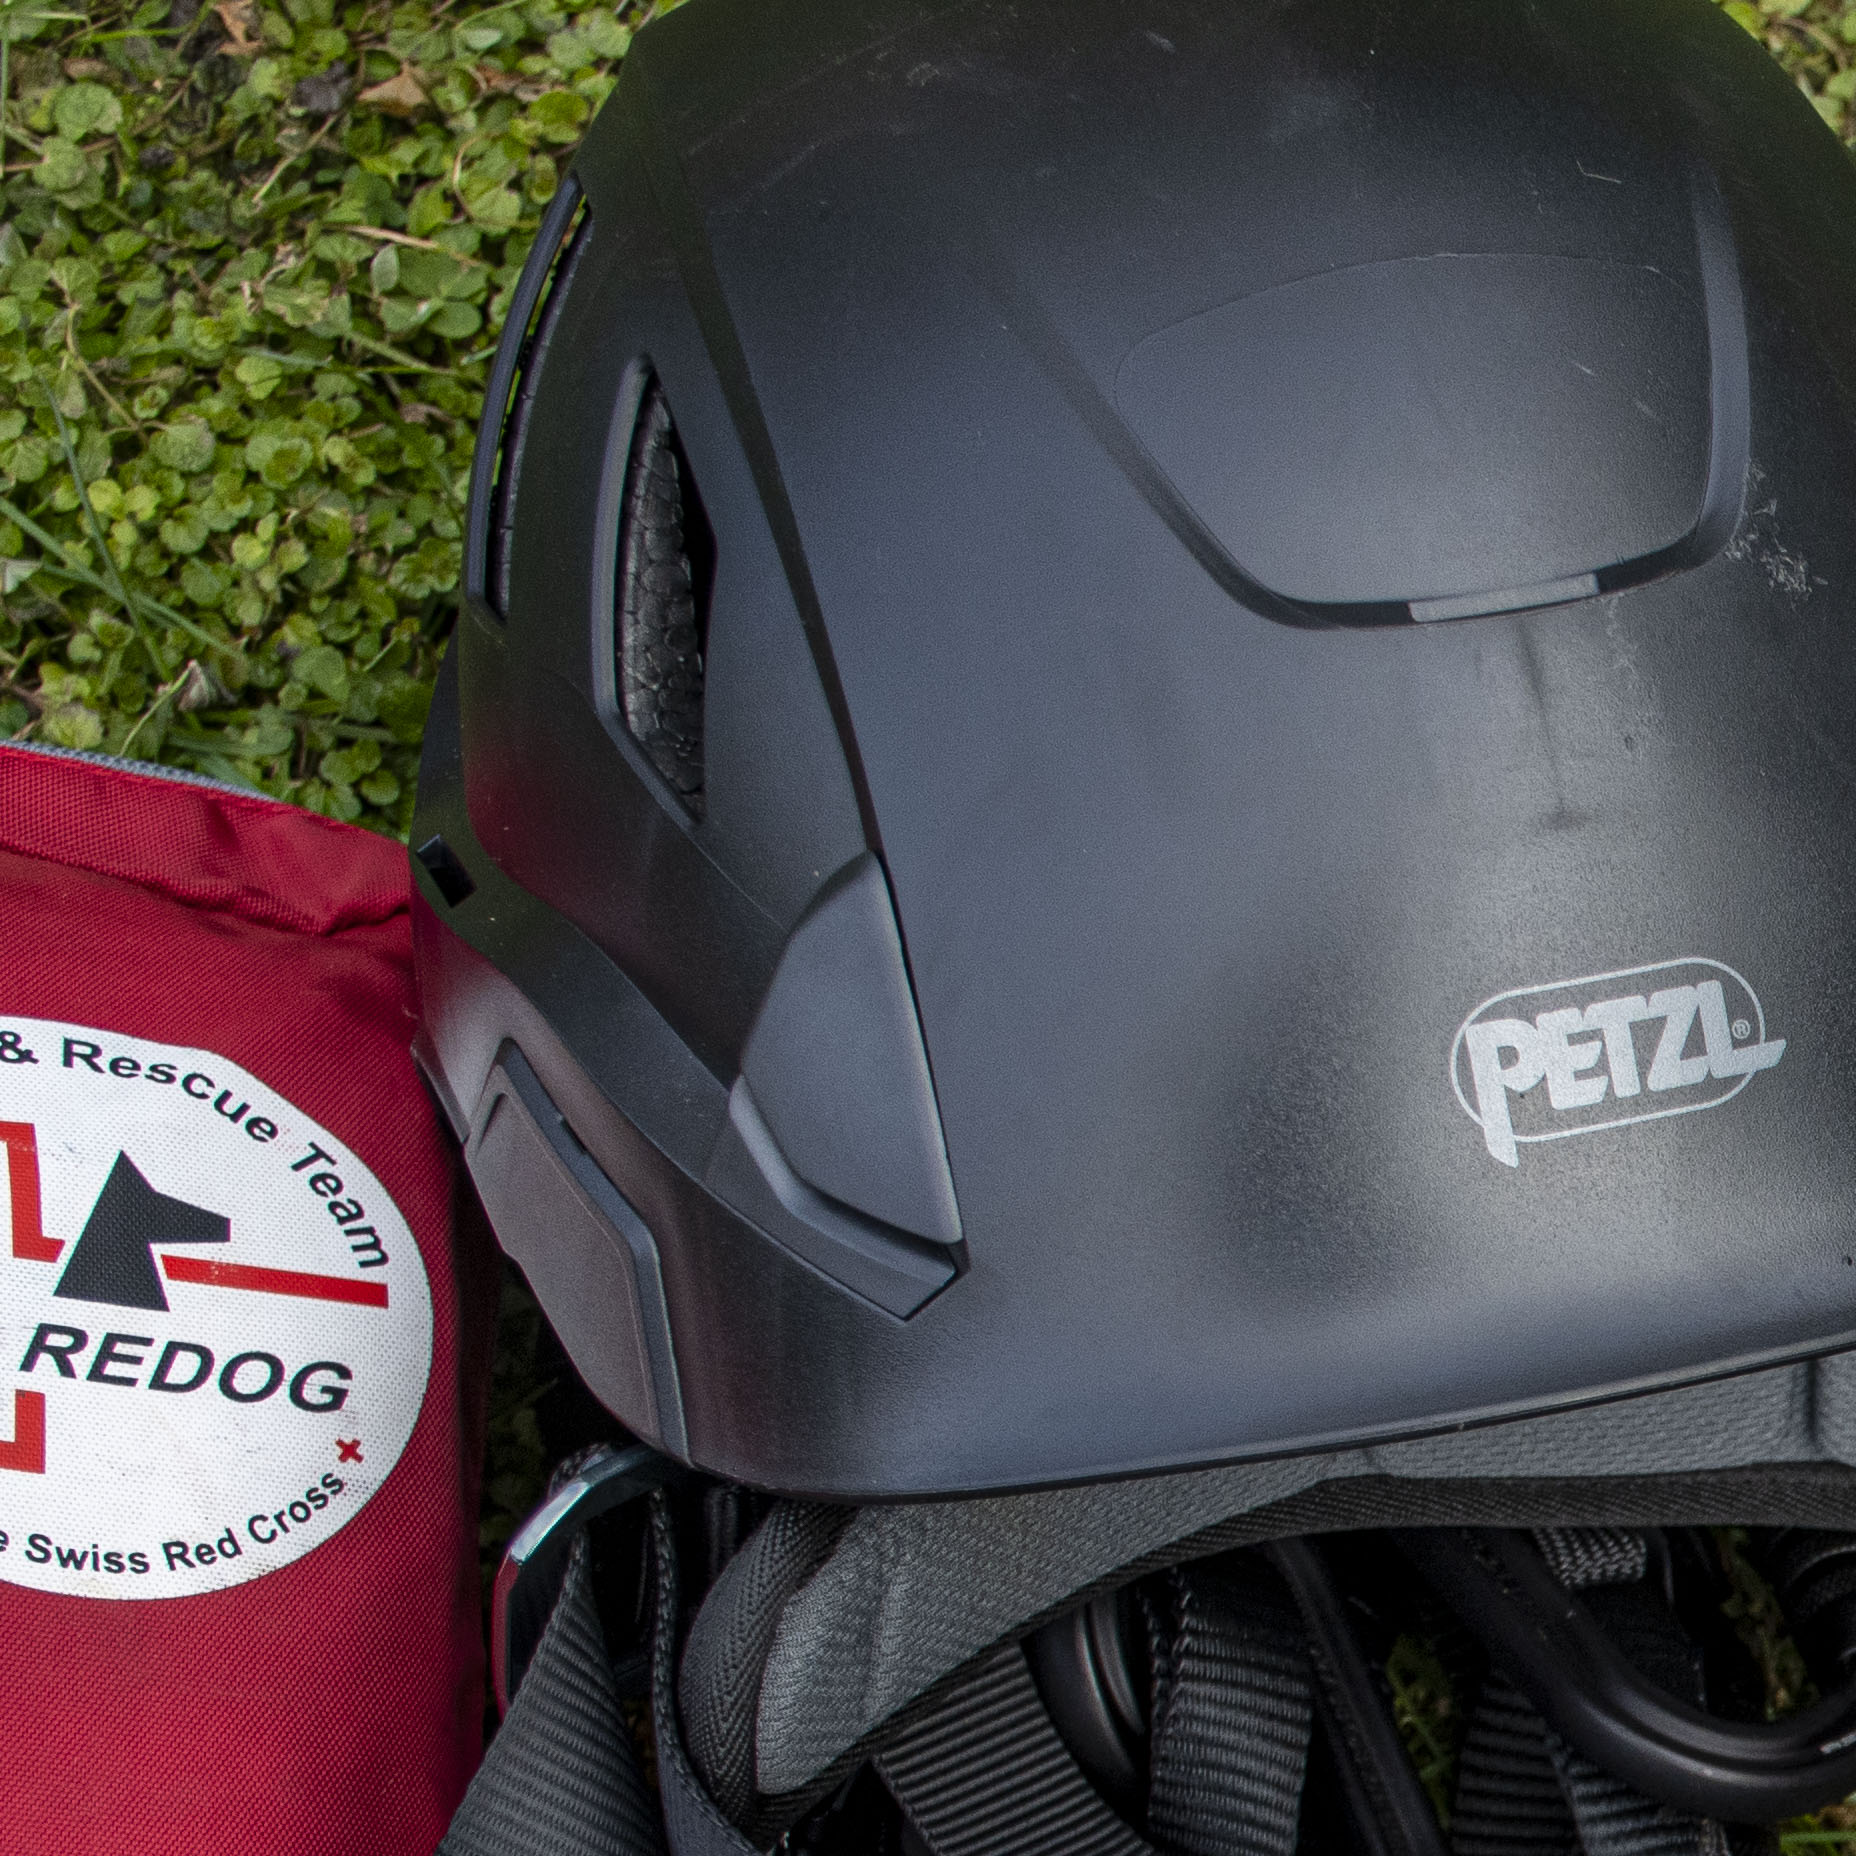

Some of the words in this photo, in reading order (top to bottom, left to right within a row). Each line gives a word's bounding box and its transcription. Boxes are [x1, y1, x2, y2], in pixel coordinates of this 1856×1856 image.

[1466, 979, 1786, 1168] PETZL
[0, 1030, 39, 1064] &
[62, 1036, 279, 1143] Rescue
[289, 1141, 389, 1268] Team
[20, 1323, 353, 1412] REDOG
[25, 1533, 149, 1573] Swiss
[163, 1528, 241, 1572] Red
[249, 1472, 343, 1543] Cross
